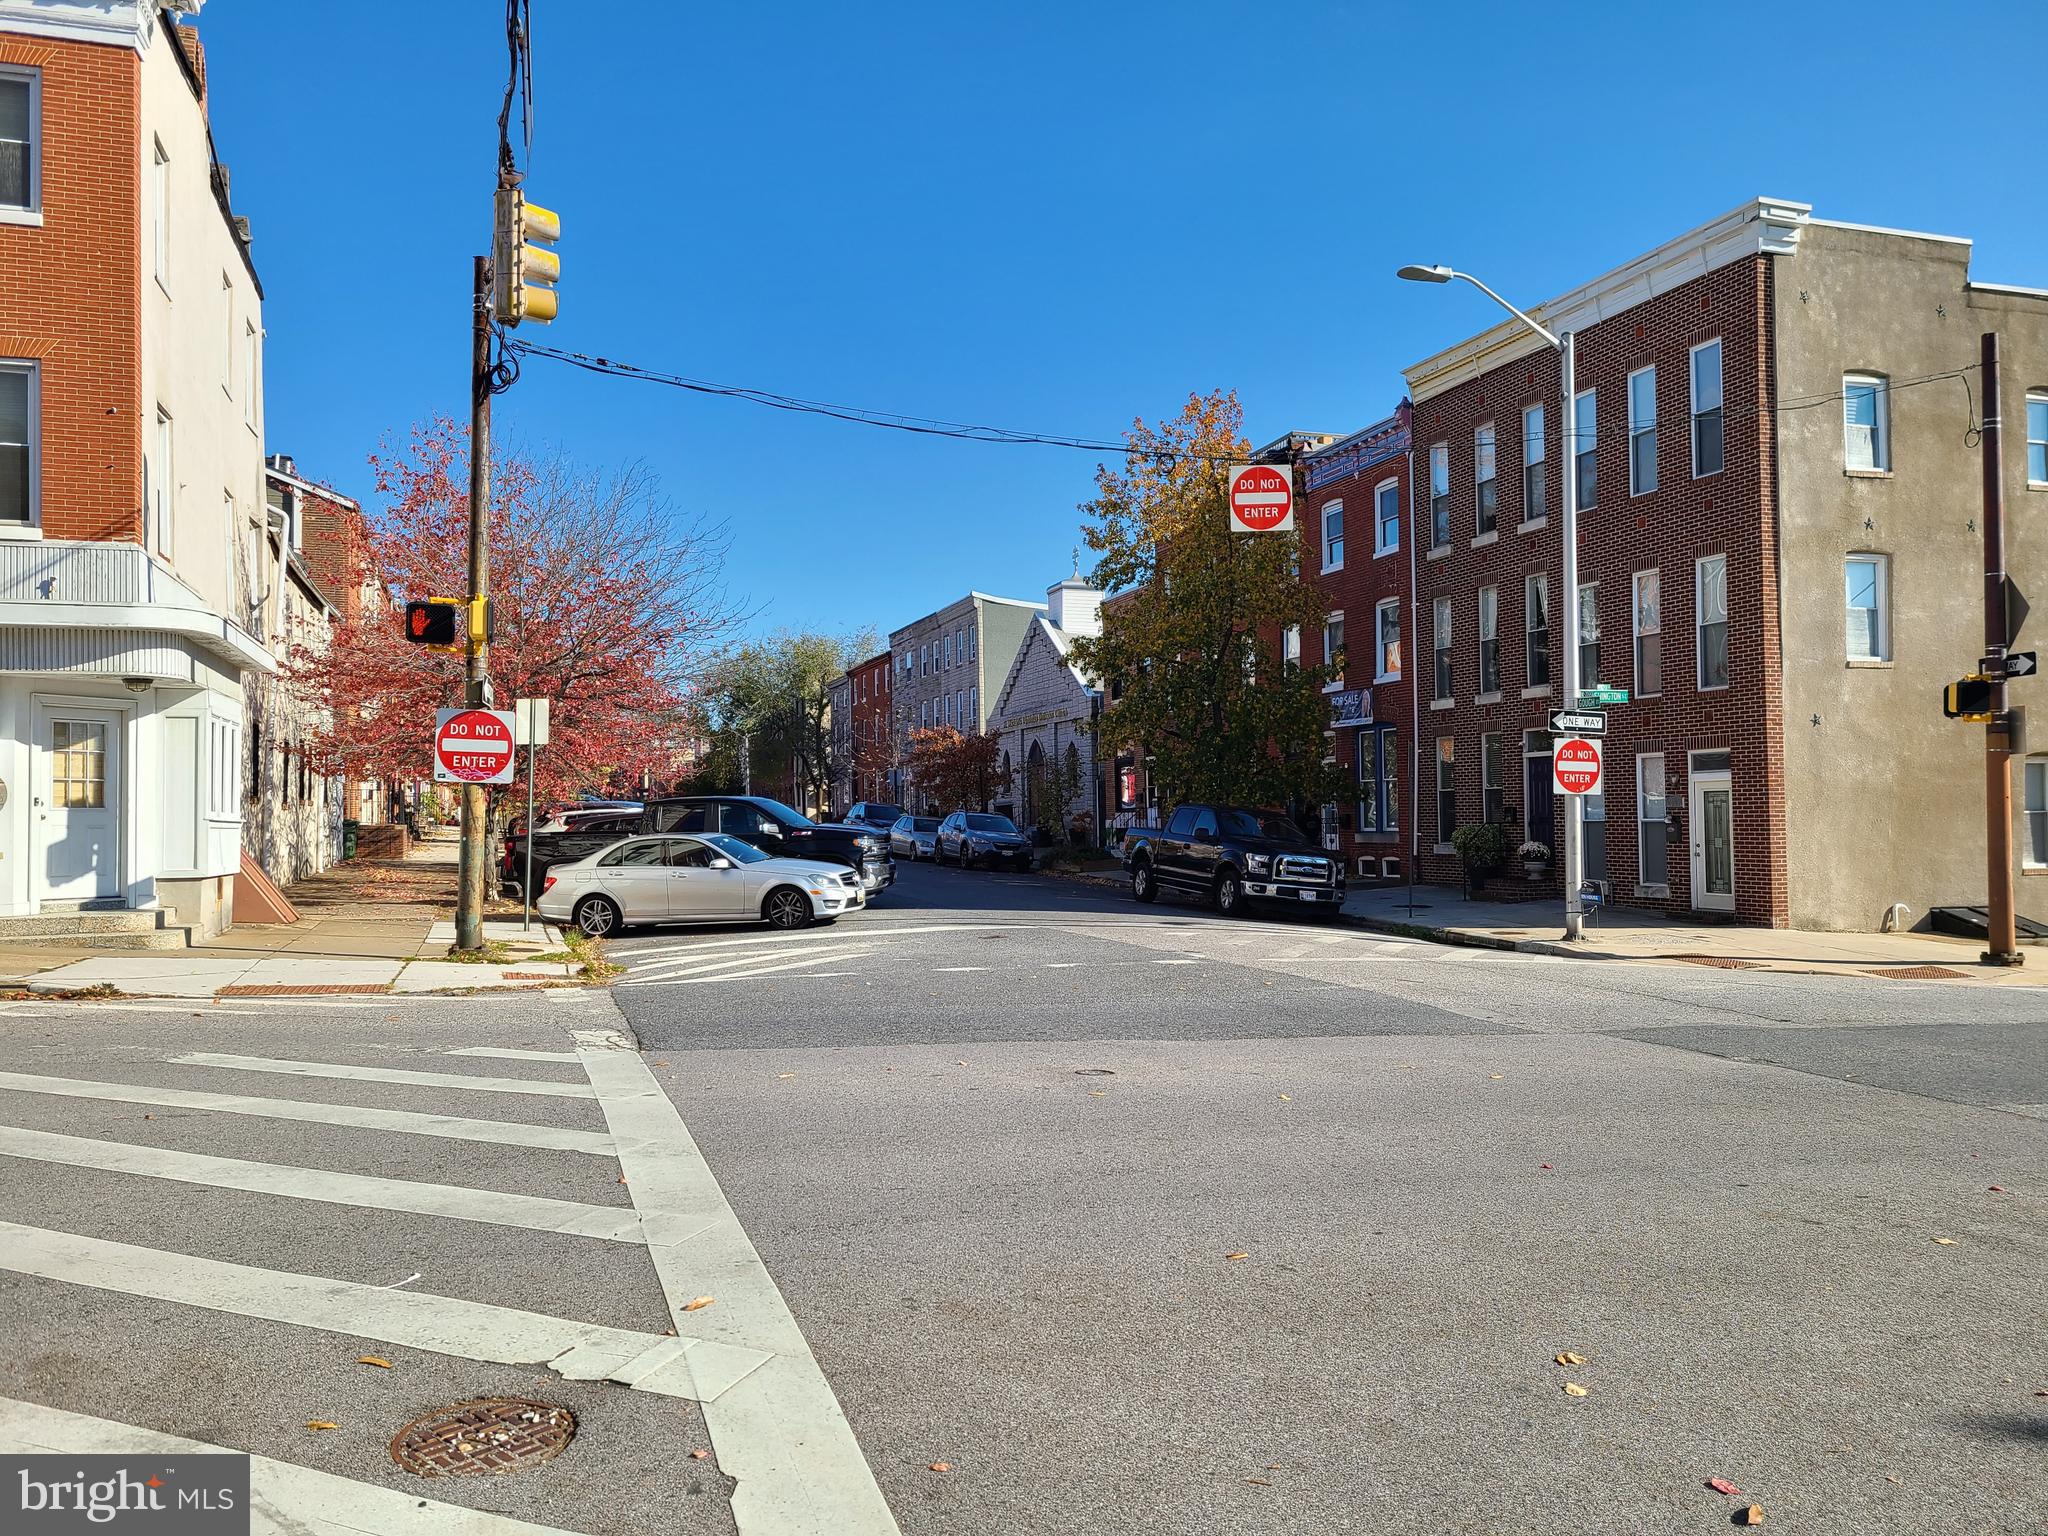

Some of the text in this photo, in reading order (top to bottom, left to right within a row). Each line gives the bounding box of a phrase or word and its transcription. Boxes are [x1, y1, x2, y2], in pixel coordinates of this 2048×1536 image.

[1240, 478, 1281, 490] DO NOT
[1244, 507, 1279, 518] ENTER
[1331, 694, 1359, 706] FOR SALE
[1578, 698, 1595, 708] GOUGH
[1562, 716, 1601, 727] ONE WAY
[450, 723, 501, 737] DO NOT
[1562, 750, 1593, 760] DO NOT
[453, 755, 496, 768] ENTER
[1563, 773, 1591, 783] ENTER
